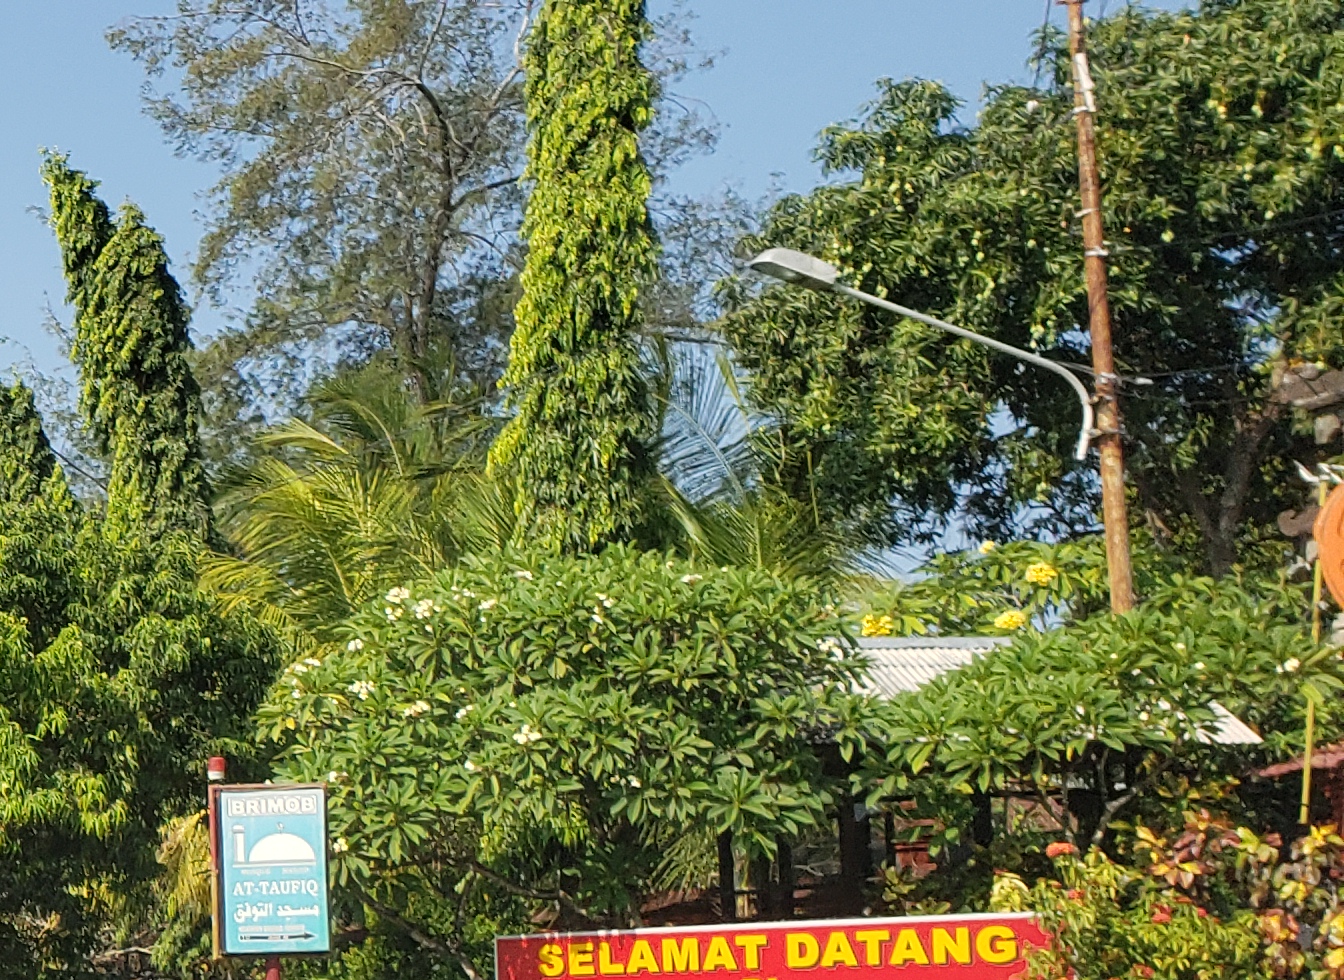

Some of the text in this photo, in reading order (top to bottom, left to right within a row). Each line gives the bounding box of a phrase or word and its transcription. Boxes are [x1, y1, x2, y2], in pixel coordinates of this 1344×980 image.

[231, 797, 315, 815] BRIMOB
[232, 879, 319, 897] AT-TAUFIQ
[538, 924, 1018, 978] SELAMAT DATANG
